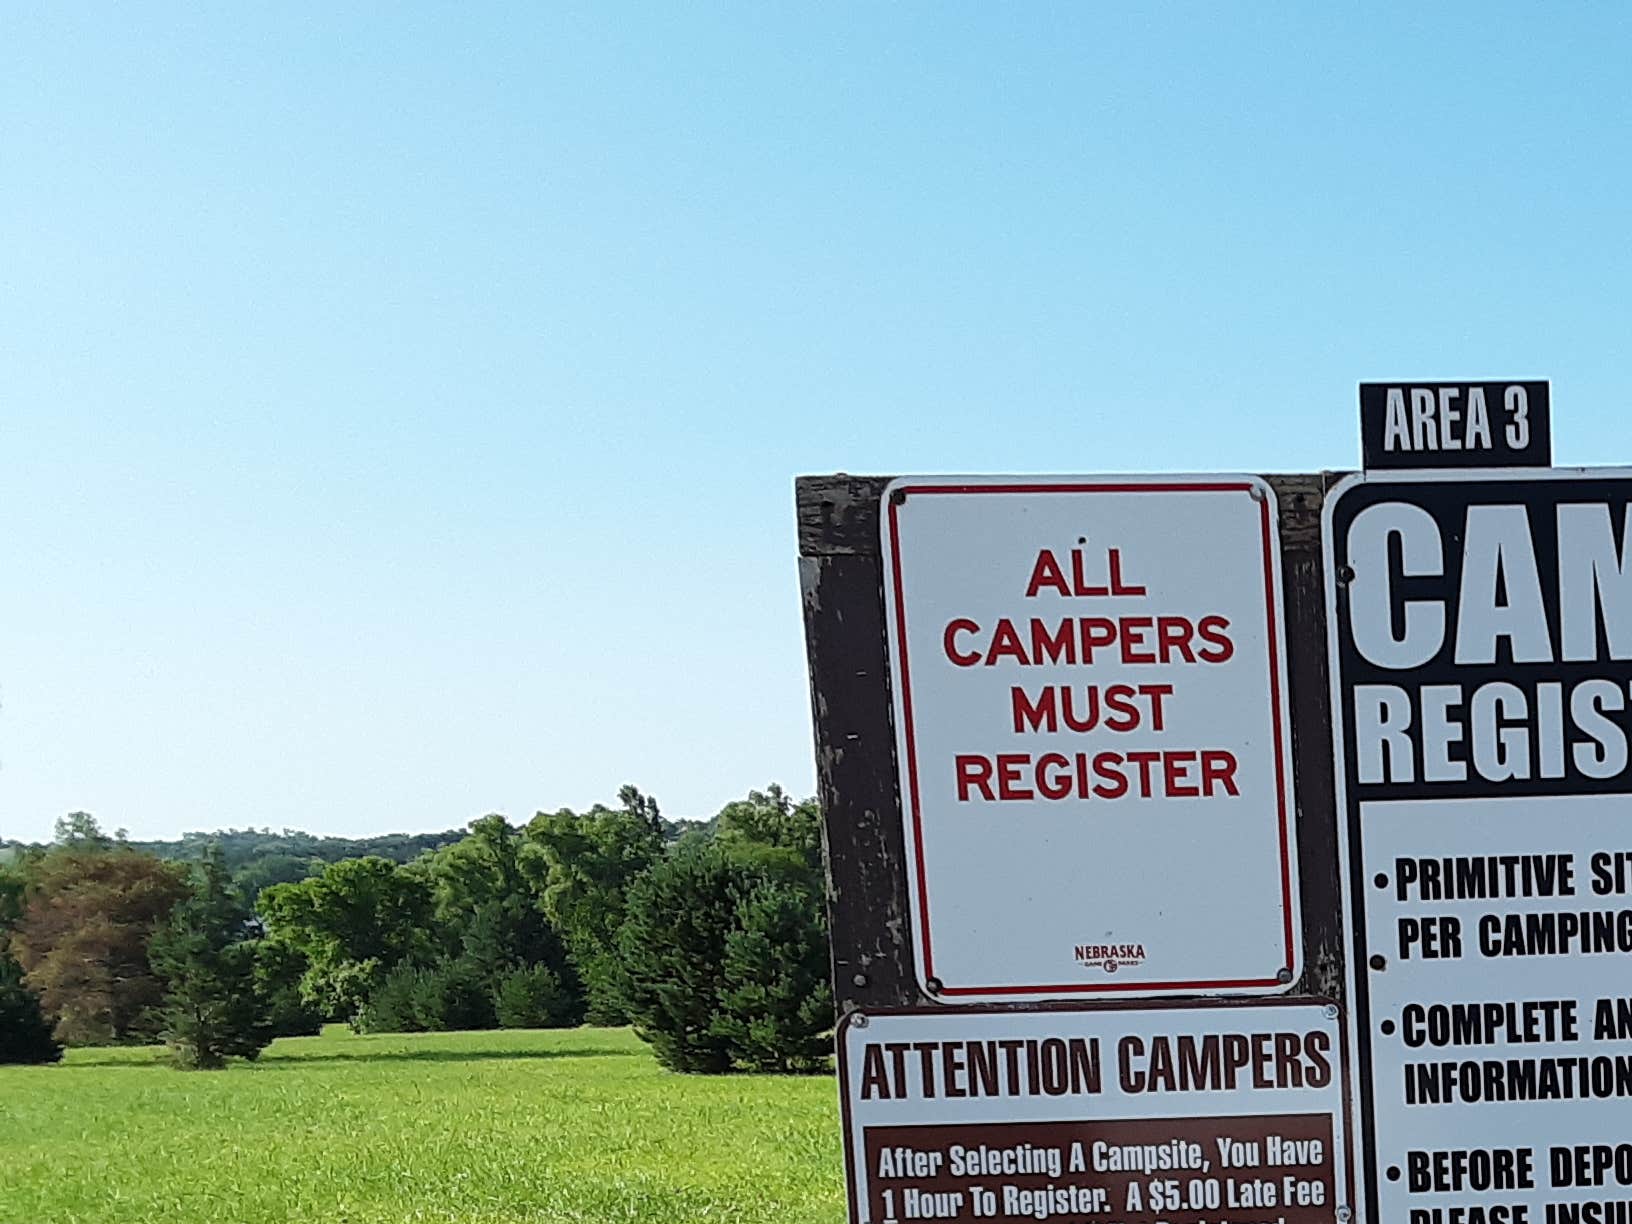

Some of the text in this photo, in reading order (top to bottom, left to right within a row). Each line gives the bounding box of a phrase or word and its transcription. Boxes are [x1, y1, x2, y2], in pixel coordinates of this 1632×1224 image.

[1384, 385, 1529, 451] AREA 3
[1025, 548, 1146, 597] ALL
[943, 615, 1235, 667] CAMPERS
[1010, 684, 1174, 734] MUST
[955, 750, 1240, 801] REGISTER
[1396, 855, 1575, 901] PRIMITIVE
[1075, 944, 1145, 960] NEBRASKA
[1398, 916, 1462, 959] PER
[1402, 1001, 1578, 1047] COMPLETE
[861, 1030, 1331, 1099] ATTENTION CAMPERS
[879, 1136, 1323, 1178] After Selecting A Campsite, You Have
[1408, 1148, 1534, 1193] BEFORE
[882, 1177, 1324, 1224] 1 Hour To Register. A $5.00 Late Fee
